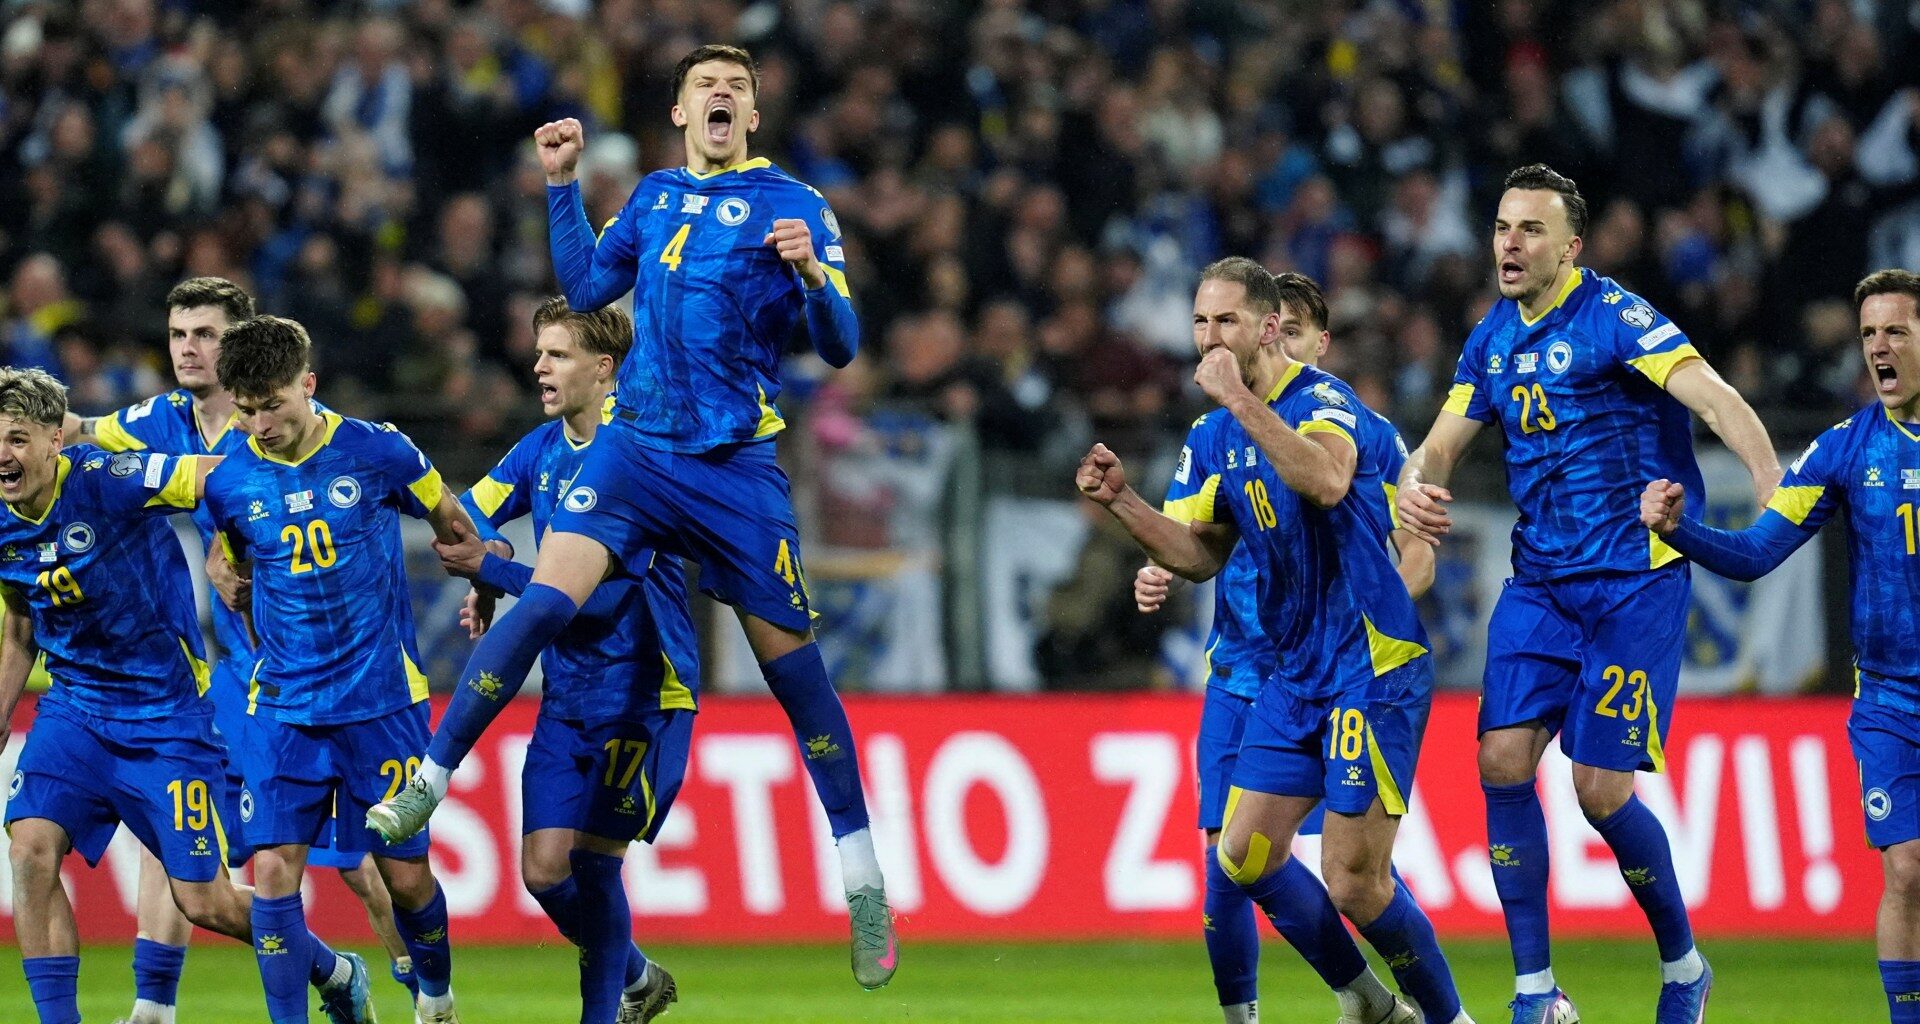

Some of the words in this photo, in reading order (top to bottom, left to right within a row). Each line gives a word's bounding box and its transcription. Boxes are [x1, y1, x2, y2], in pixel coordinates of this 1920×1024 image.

[659, 223, 691, 272] 4
[1512, 383, 1556, 434] 23
[1244, 479, 1278, 531] 18
[1896, 503, 1920, 555] 1
[281, 519, 337, 574] 20
[774, 538, 796, 588] 4
[36, 566, 84, 607] 19
[1595, 665, 1647, 721] 23
[1330, 708, 1365, 761] 18
[1621, 739, 1642, 747] KELME
[604, 738, 648, 789] 17
[166, 780, 209, 831] 19
[430, 733, 1050, 917] SETNO
[1089, 732, 1843, 914] ZAEVI!
